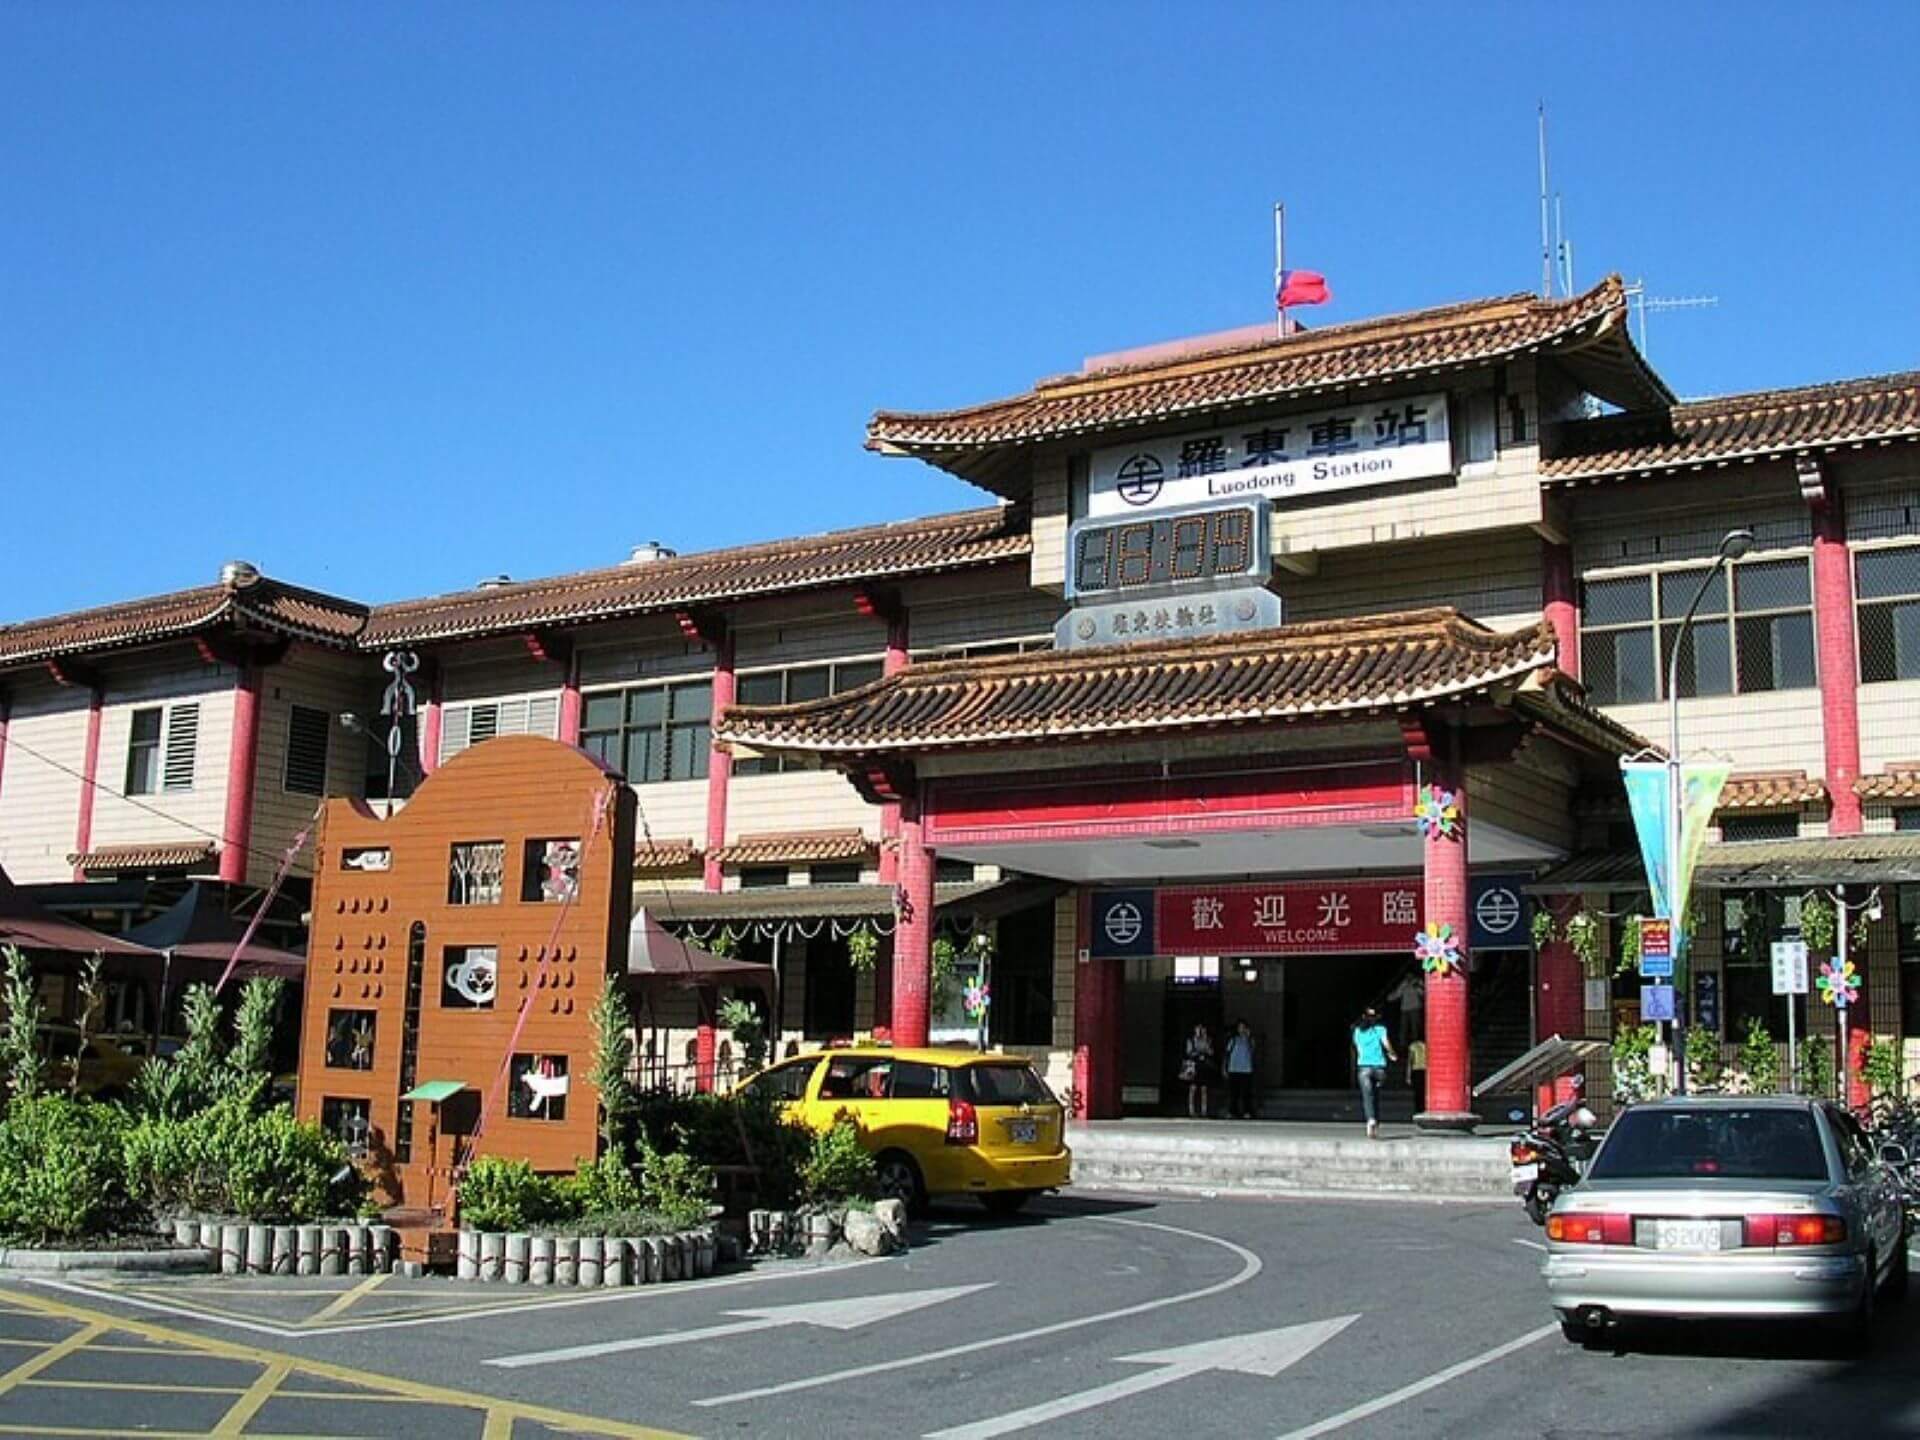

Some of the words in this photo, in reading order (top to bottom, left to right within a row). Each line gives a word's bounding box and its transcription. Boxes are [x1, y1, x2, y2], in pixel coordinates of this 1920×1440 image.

[1178, 405, 1427, 478] 羅東車站
[1207, 470, 1296, 497] Luodong
[1312, 457, 1393, 481] Station
[1192, 890, 1417, 930] 歡迎光臨
[1264, 928, 1339, 944] WELCOME
